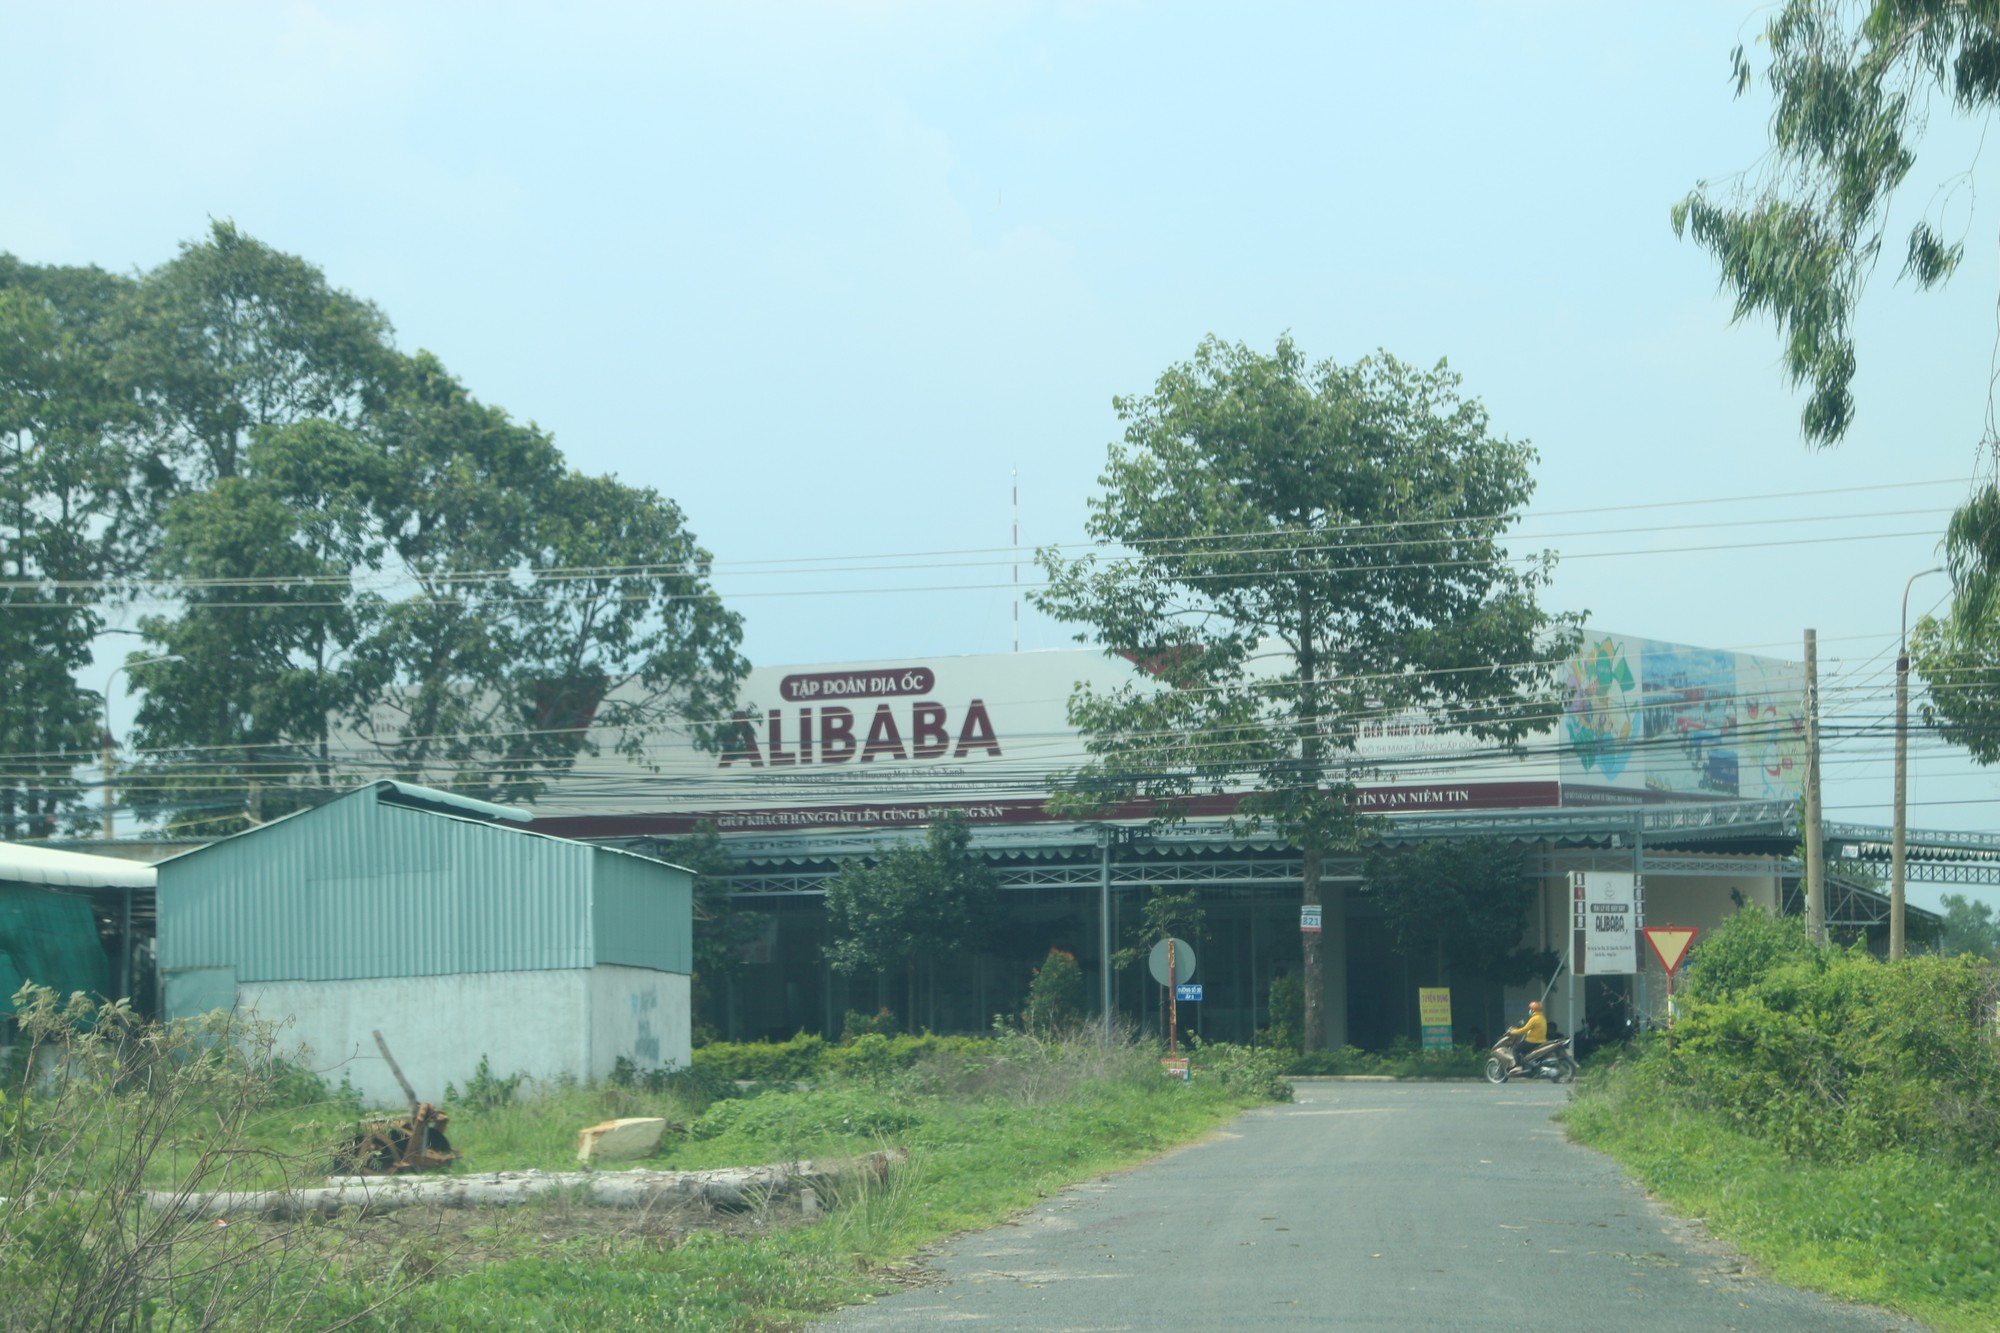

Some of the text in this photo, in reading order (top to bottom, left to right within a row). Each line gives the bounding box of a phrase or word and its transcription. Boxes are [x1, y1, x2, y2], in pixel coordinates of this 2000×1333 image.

[790, 671, 924, 698] TẬP ĐOÀN ĐỊA ỐC
[718, 699, 1003, 768] ALIBABA
[1379, 793, 1406, 807] VẠN
[1446, 790, 1469, 802] TIN
